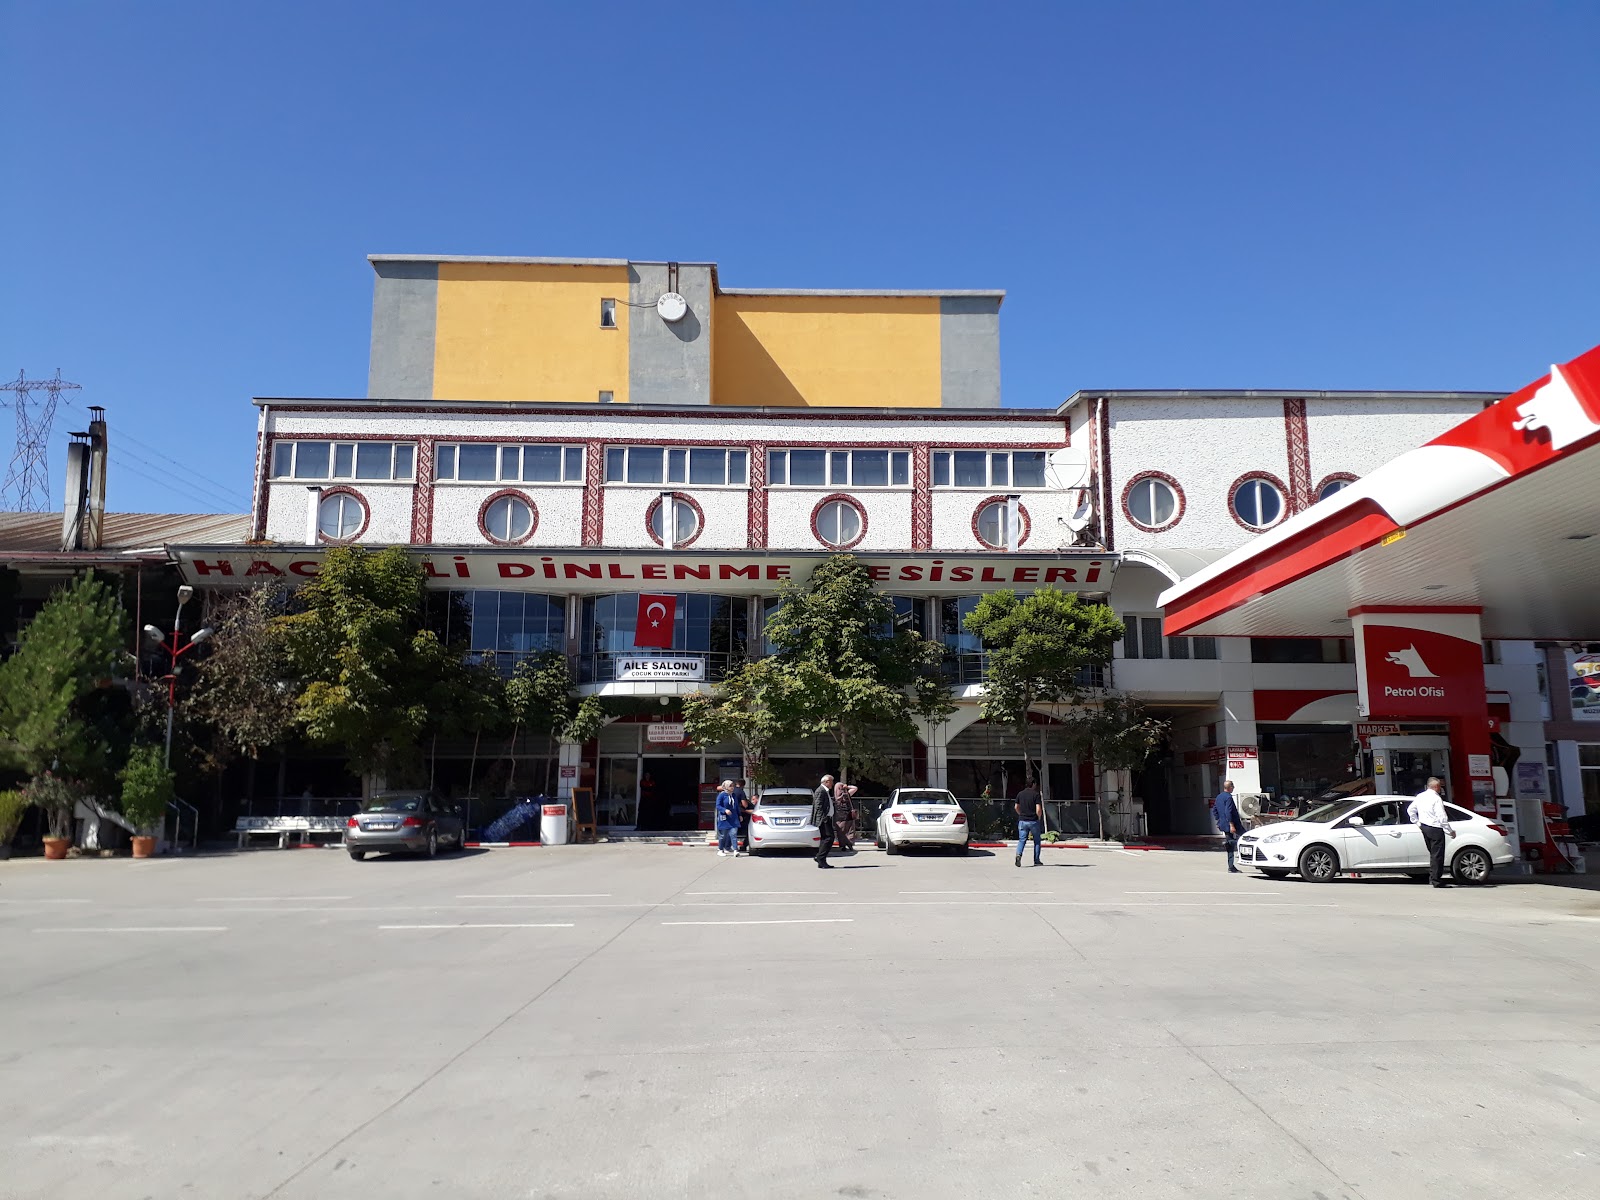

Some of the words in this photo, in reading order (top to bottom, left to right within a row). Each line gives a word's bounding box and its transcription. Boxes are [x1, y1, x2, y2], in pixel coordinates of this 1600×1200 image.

[497, 556, 792, 580] DİNLENME
[866, 559, 1103, 584] ESİSLERİ
[623, 660, 648, 670] AİLE
[652, 661, 698, 671] SALONU
[1384, 686, 1417, 697] Petrol
[1418, 686, 1445, 697] Ofisi
[1358, 725, 1394, 734] MARKET
[1488, 719, 1495, 729] 9
